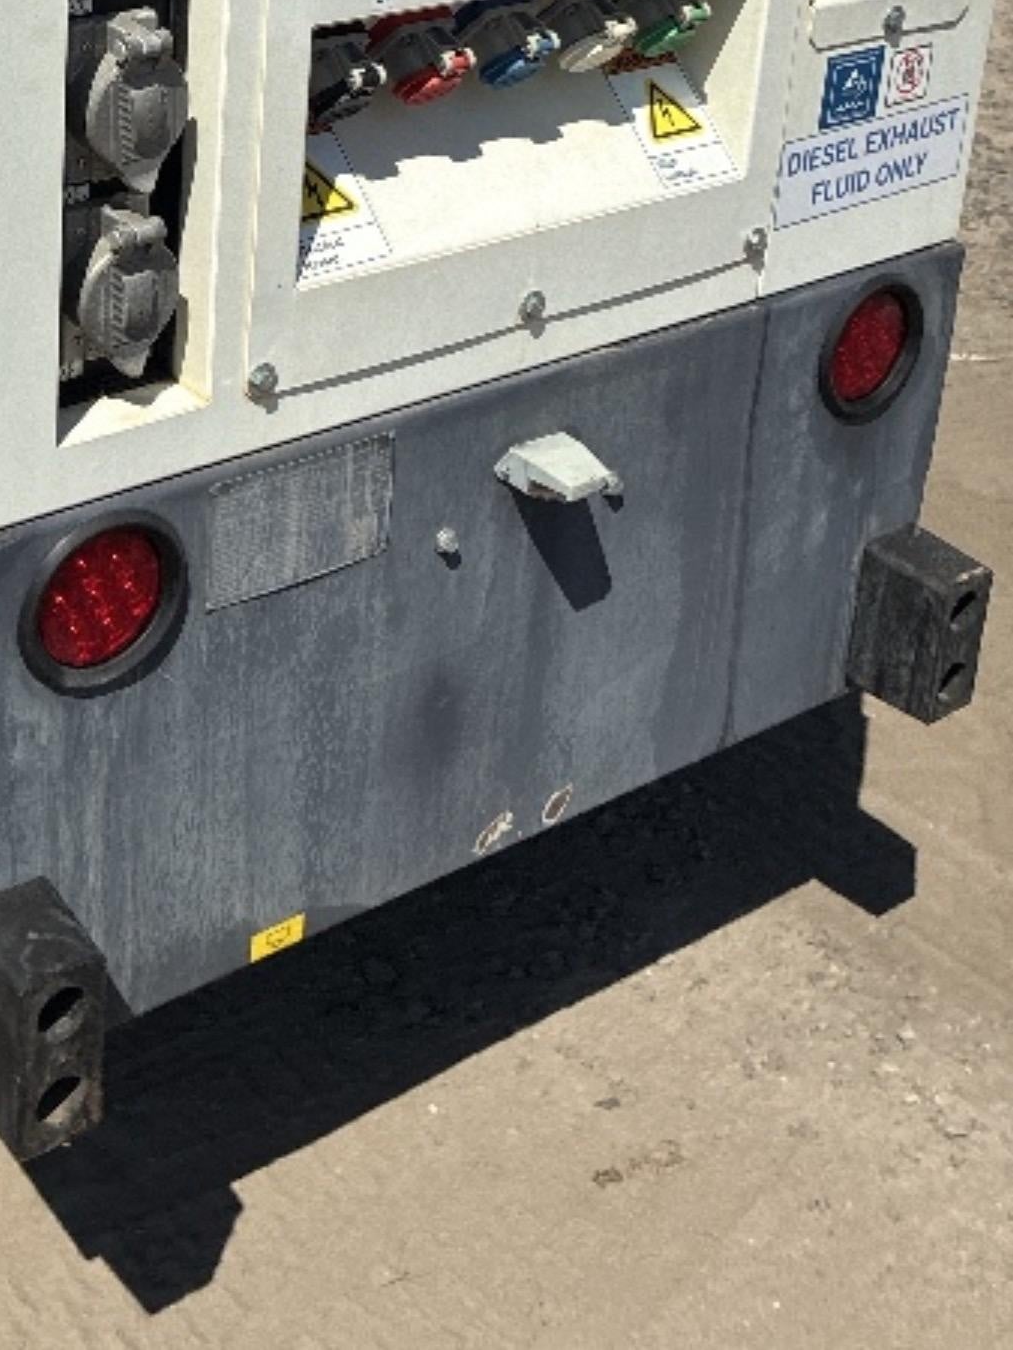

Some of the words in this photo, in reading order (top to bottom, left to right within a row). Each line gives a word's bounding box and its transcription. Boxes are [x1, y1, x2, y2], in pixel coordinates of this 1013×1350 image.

[788, 137, 858, 178] DIESEL
[864, 107, 961, 156] EXHAUST
[811, 169, 870, 206] FLUID
[874, 150, 929, 187] ONLY
